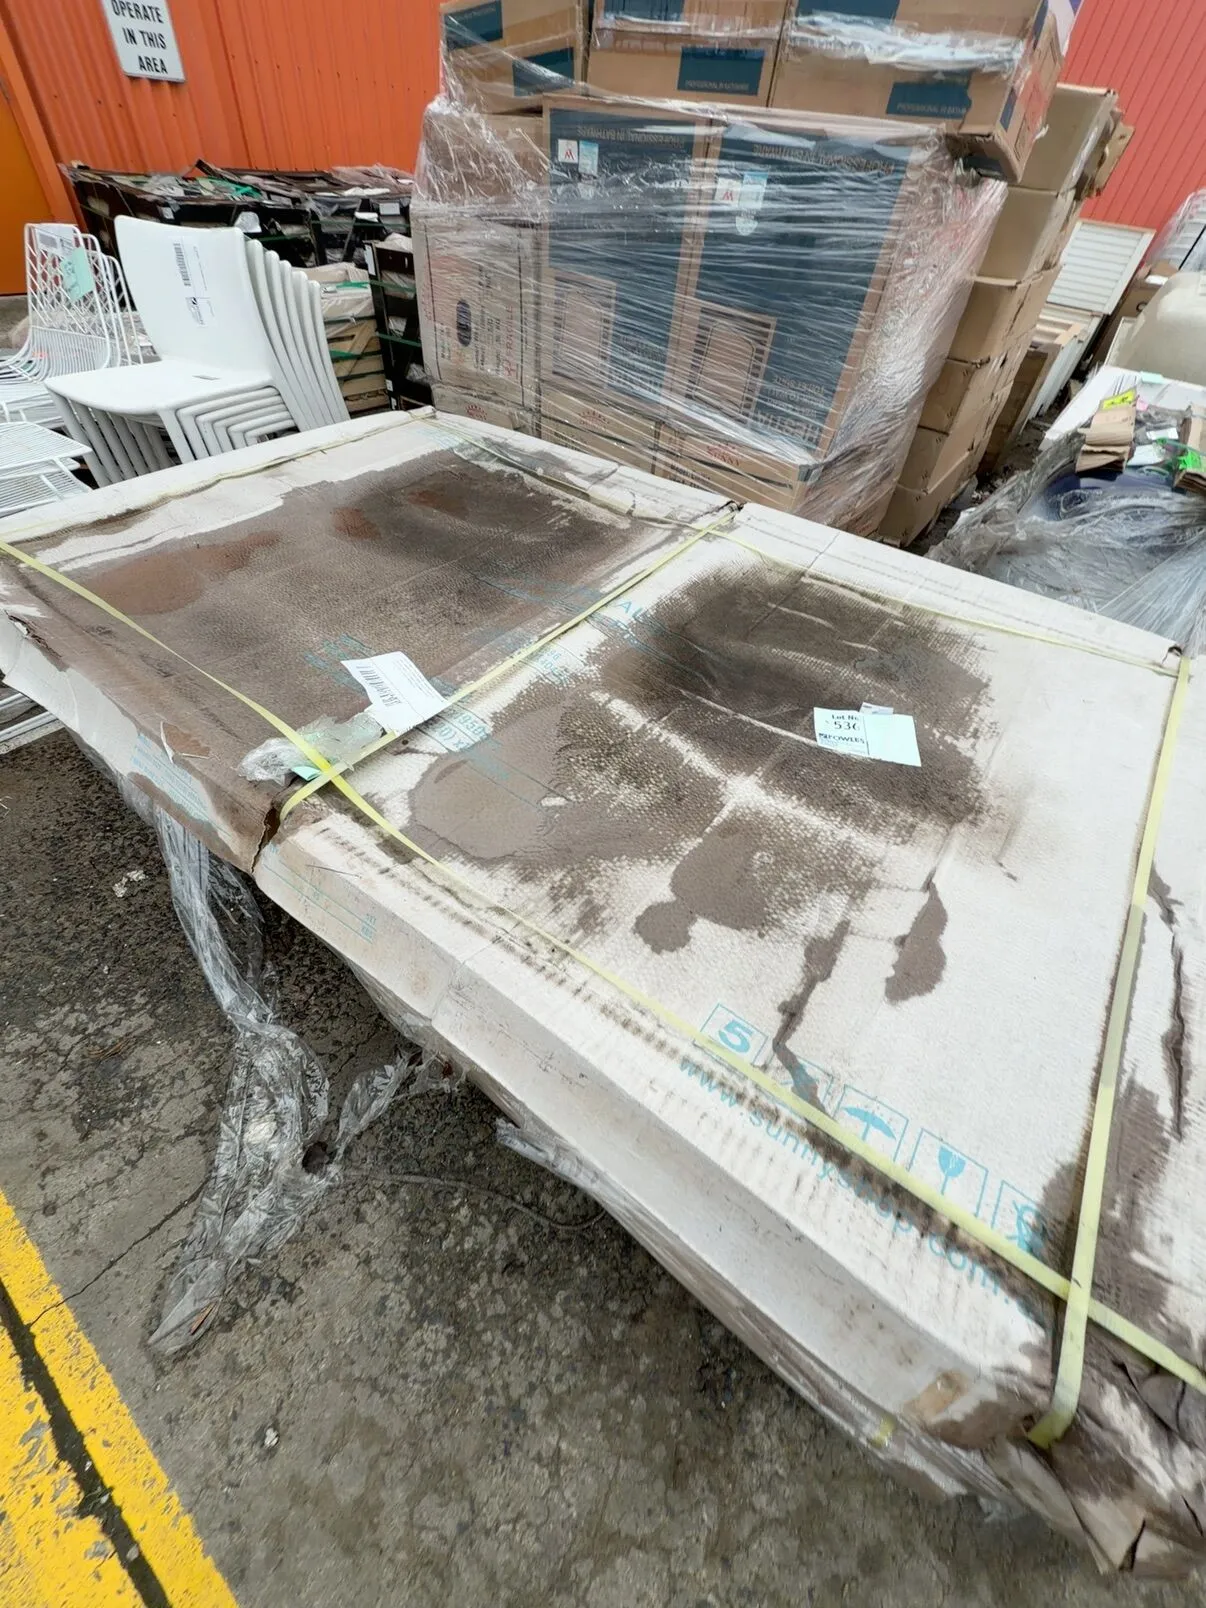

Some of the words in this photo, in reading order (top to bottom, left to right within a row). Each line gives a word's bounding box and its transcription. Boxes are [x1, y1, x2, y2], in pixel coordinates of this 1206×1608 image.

[111, 0, 164, 23] OPERATE
[122, 27, 137, 45] IN
[139, 30, 167, 50] THIS
[138, 55, 168, 74] AREA
[718, 1020, 753, 1053] 5
